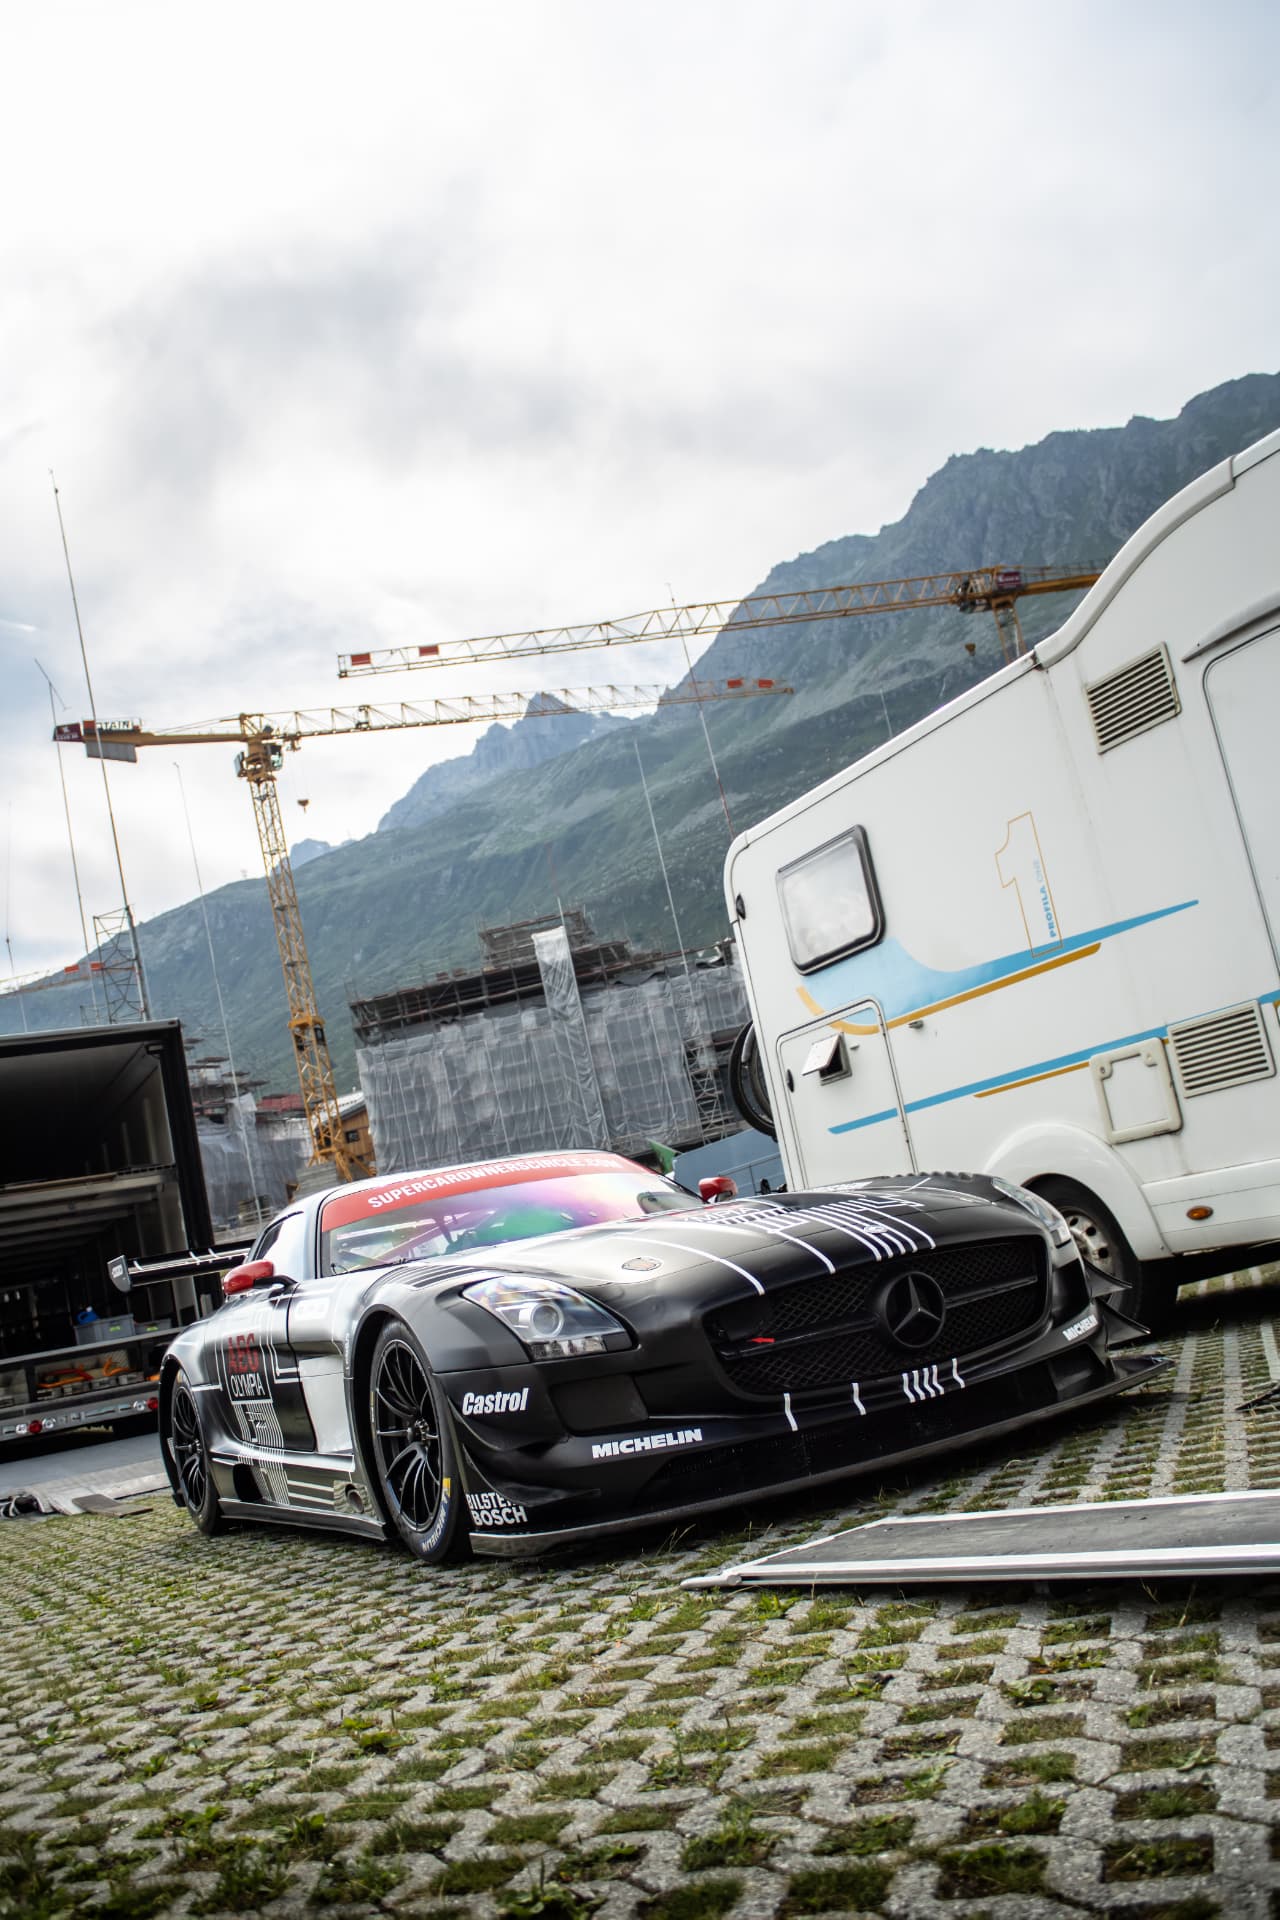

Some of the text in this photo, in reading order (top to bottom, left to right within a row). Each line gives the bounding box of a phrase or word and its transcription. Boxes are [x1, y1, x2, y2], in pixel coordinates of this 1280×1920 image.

[1040, 885, 1057, 938] PROFILA
[228, 1333, 259, 1375] AEG
[230, 1373, 266, 1398] OLYMPIA
[462, 1387, 529, 1416] Castrol
[591, 1428, 703, 1459] MICHELIN
[471, 1506, 528, 1527] BOSCH
